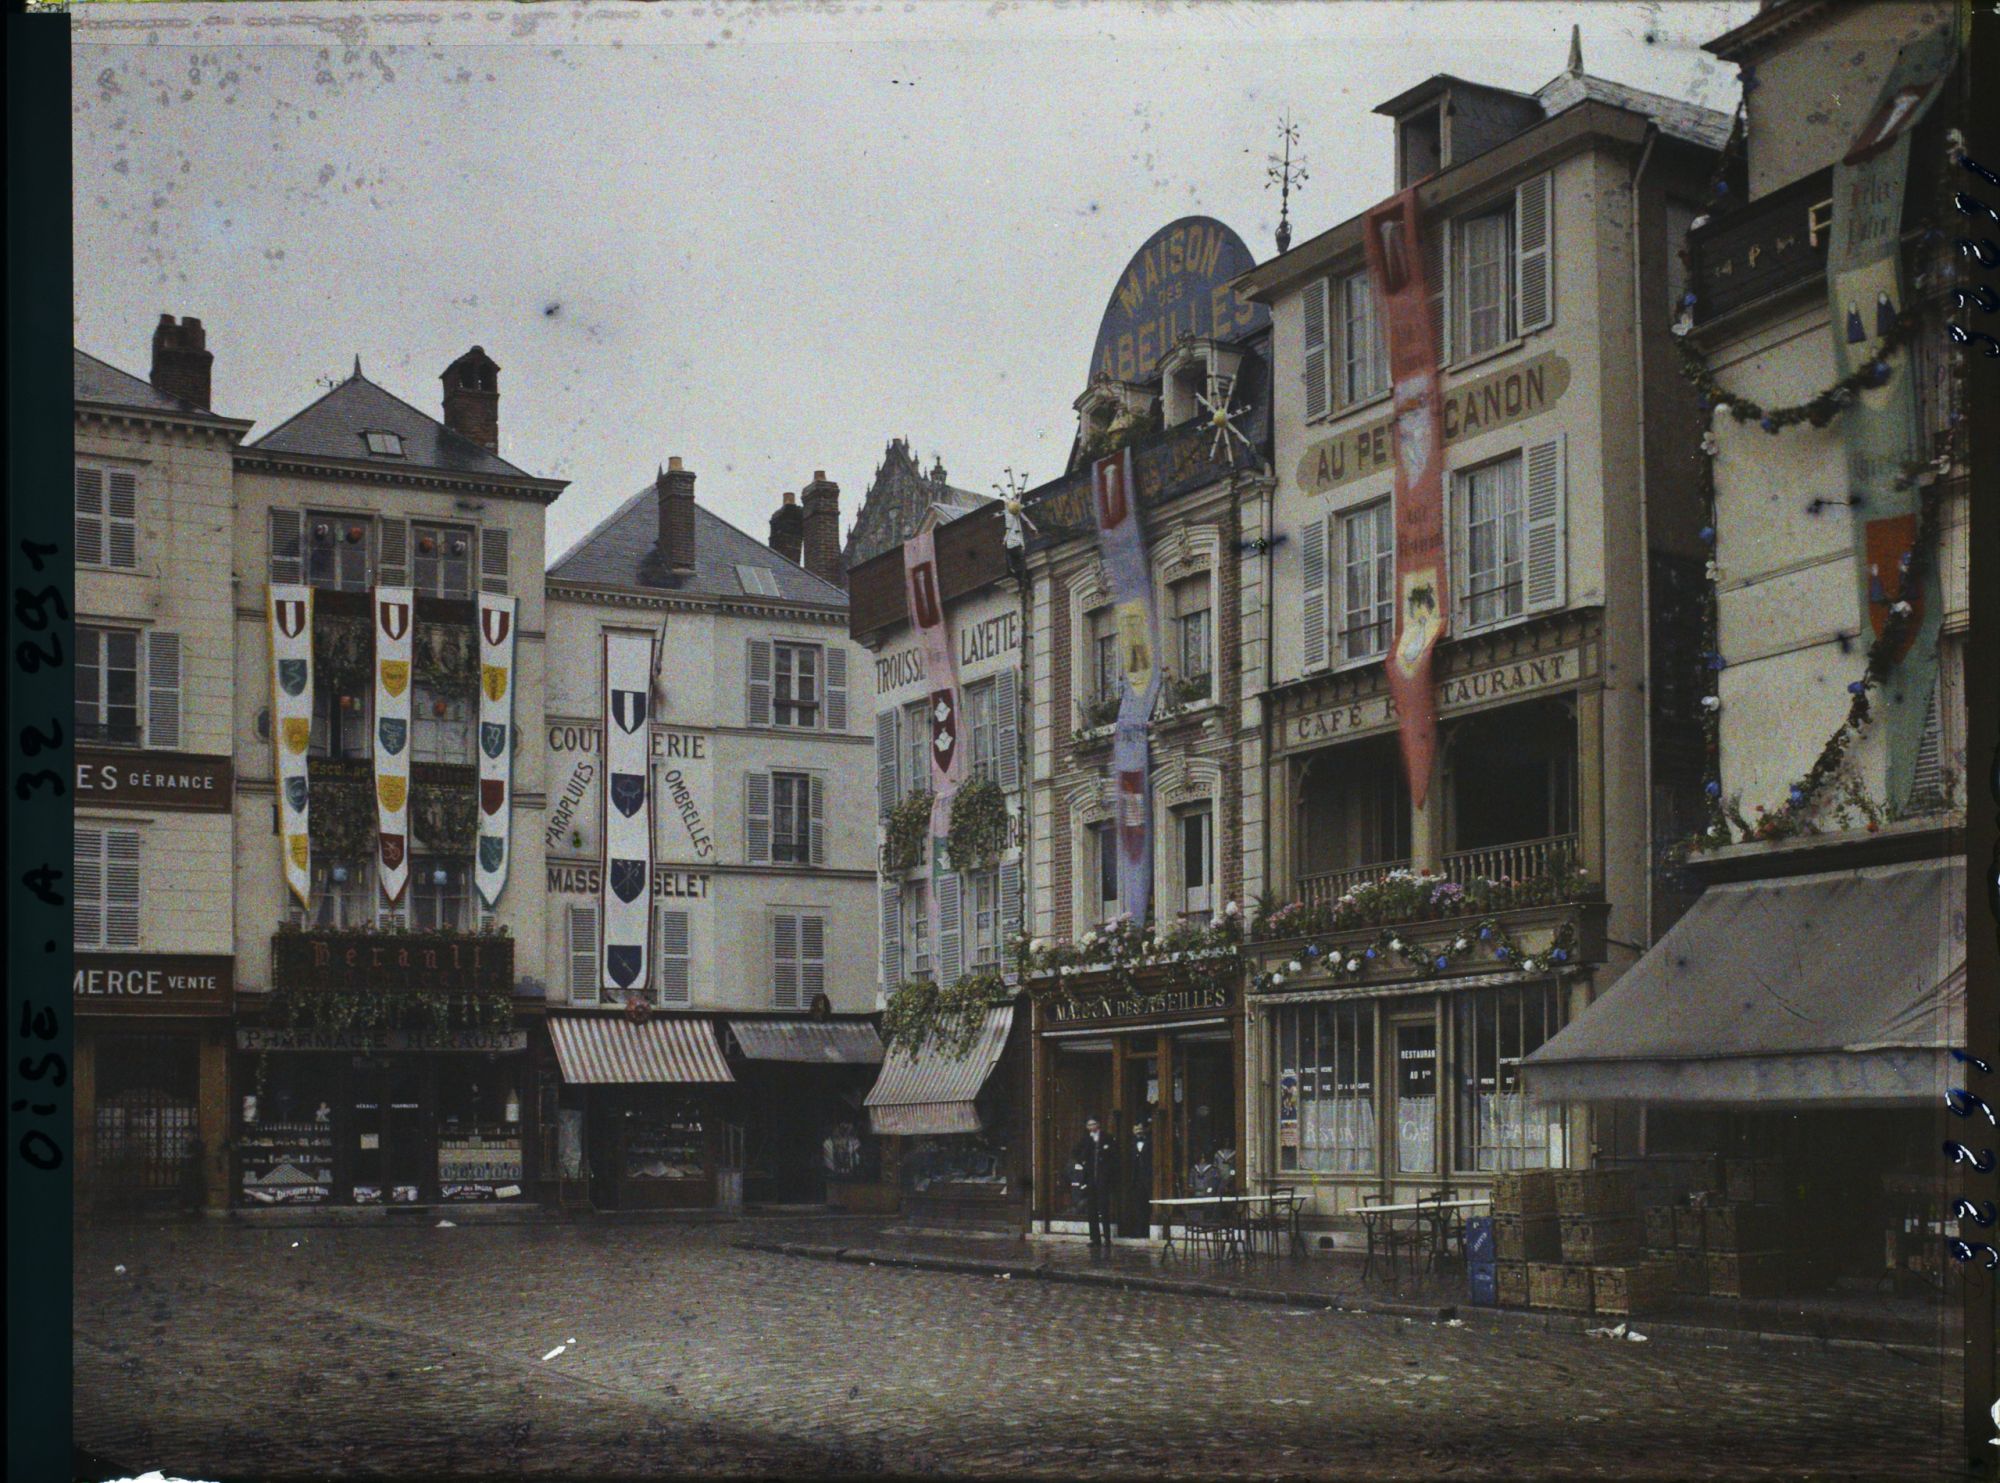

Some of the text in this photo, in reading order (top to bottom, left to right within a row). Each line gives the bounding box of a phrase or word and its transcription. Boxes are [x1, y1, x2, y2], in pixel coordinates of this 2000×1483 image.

[1118, 224, 1225, 319] MAISON
[1316, 442, 1345, 487] AU
[1443, 364, 1545, 439] CANON
[1298, 702, 1362, 740] CAFÉ
[549, 725, 705, 759] COUTERIE
[129, 769, 214, 790] GÉRANCE
[664, 769, 713, 858] OMBRELLES
[168, 975, 217, 990] VENTE
[1145, 989, 1226, 1014] ABEILLES
[1400, 1049, 1437, 1060] RESTAURAN
